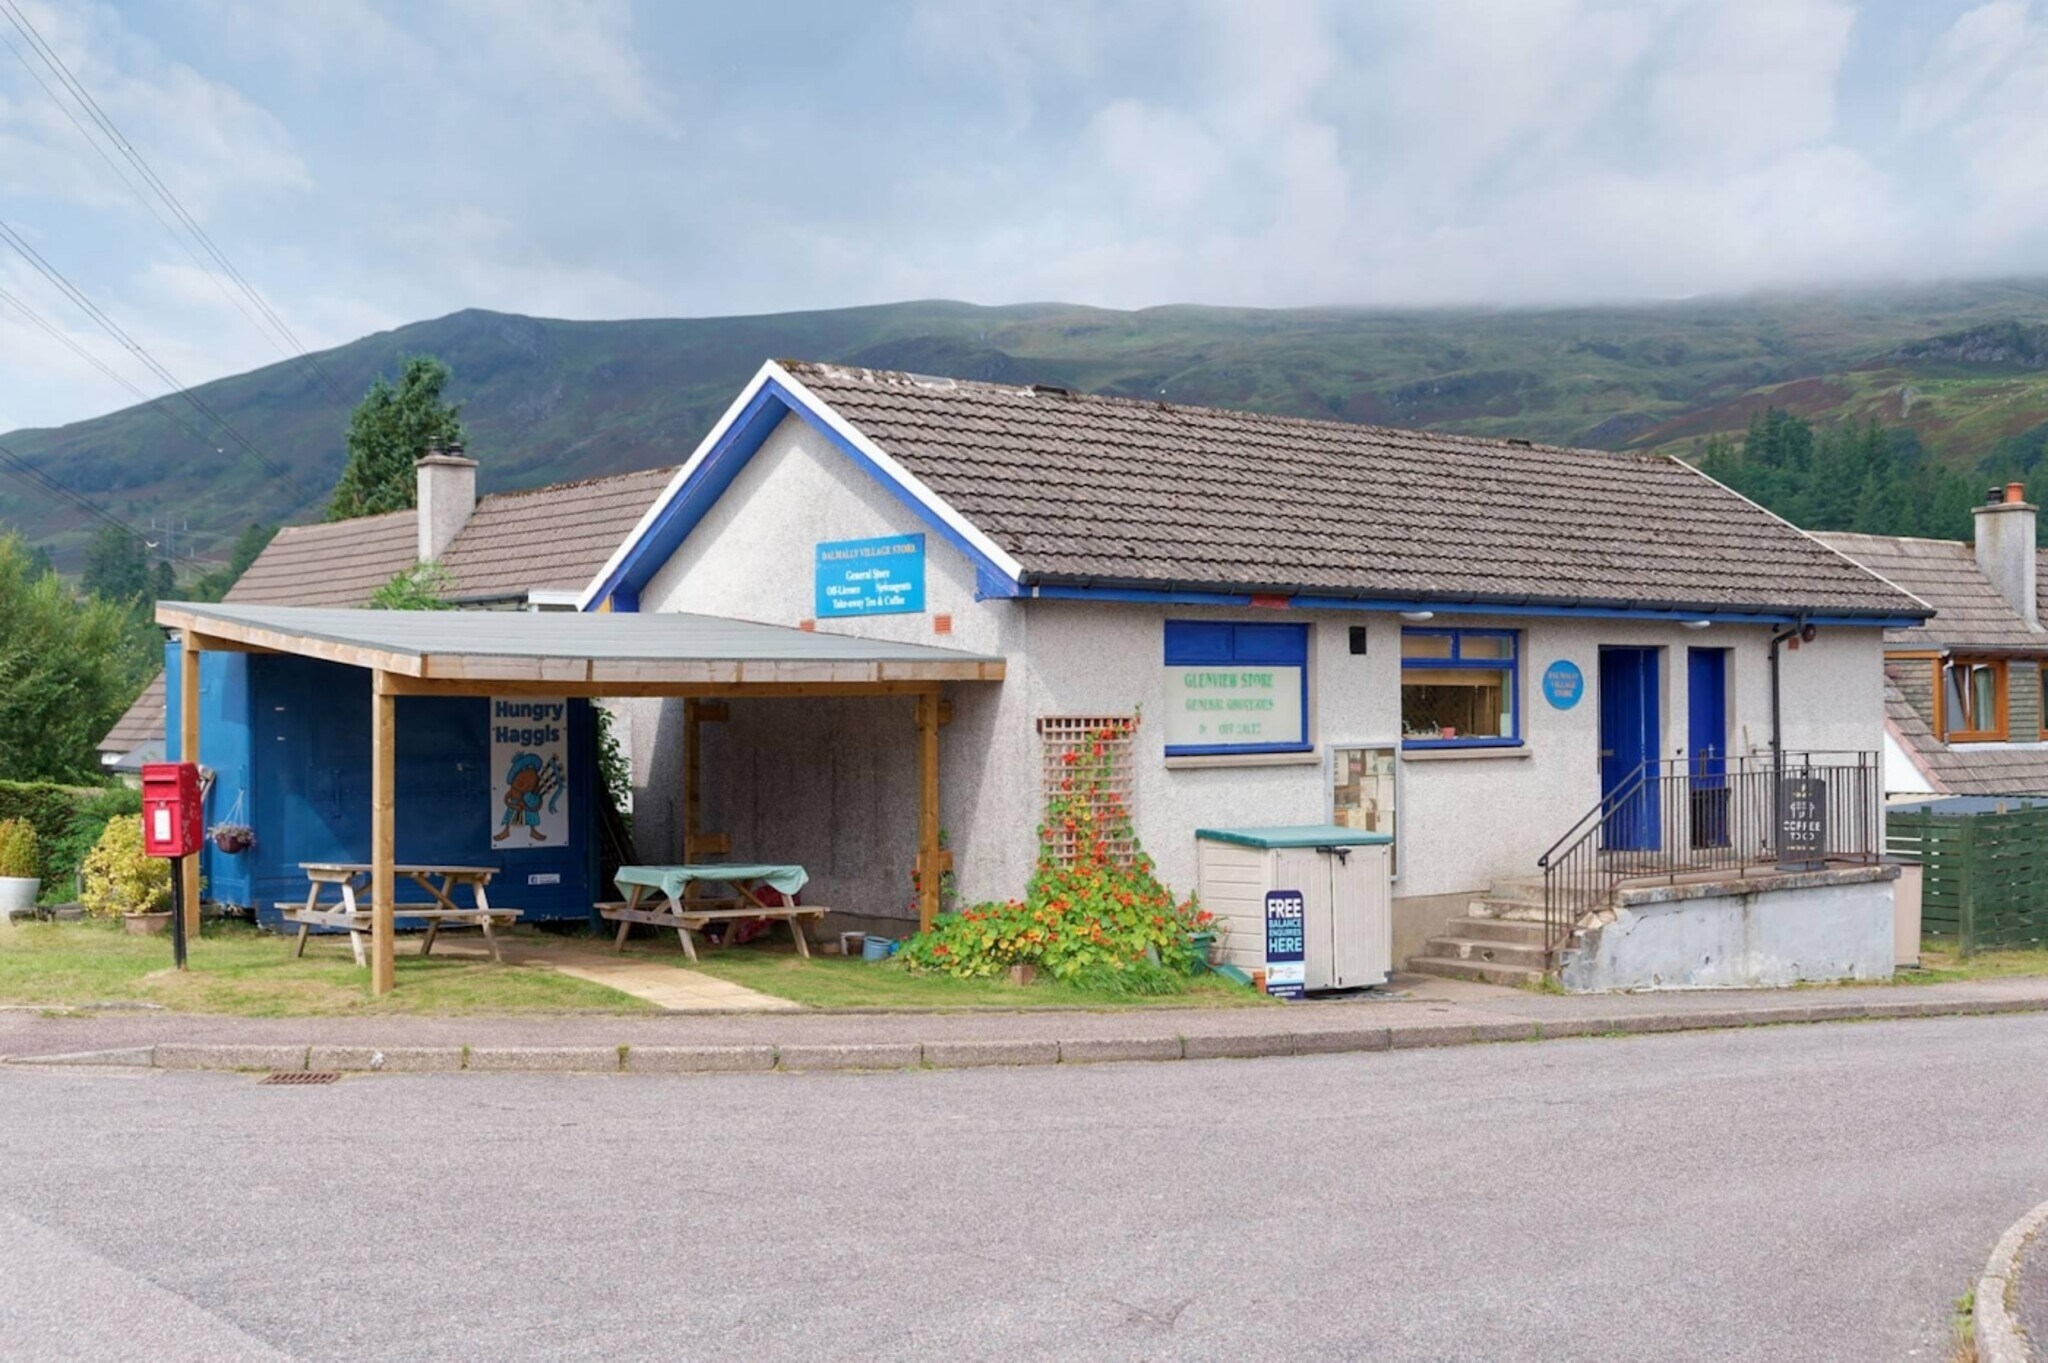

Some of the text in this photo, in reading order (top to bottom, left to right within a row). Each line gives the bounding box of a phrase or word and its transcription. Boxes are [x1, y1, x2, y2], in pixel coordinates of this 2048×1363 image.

[859, 547, 892, 557] VILLAGE
[893, 543, 915, 554] STORE
[845, 568, 890, 580] General Store
[865, 597, 876, 607] Tea
[884, 595, 905, 605] Coffee
[1184, 673, 1274, 688] GLENVIEW STORE
[496, 701, 564, 722] Hungry
[496, 724, 560, 747] Haggis
[1268, 898, 1302, 918] FREE
[1268, 919, 1302, 928] BALANCE
[1269, 928, 1302, 937] ENQUIRIES
[1269, 937, 1303, 953] HERE
